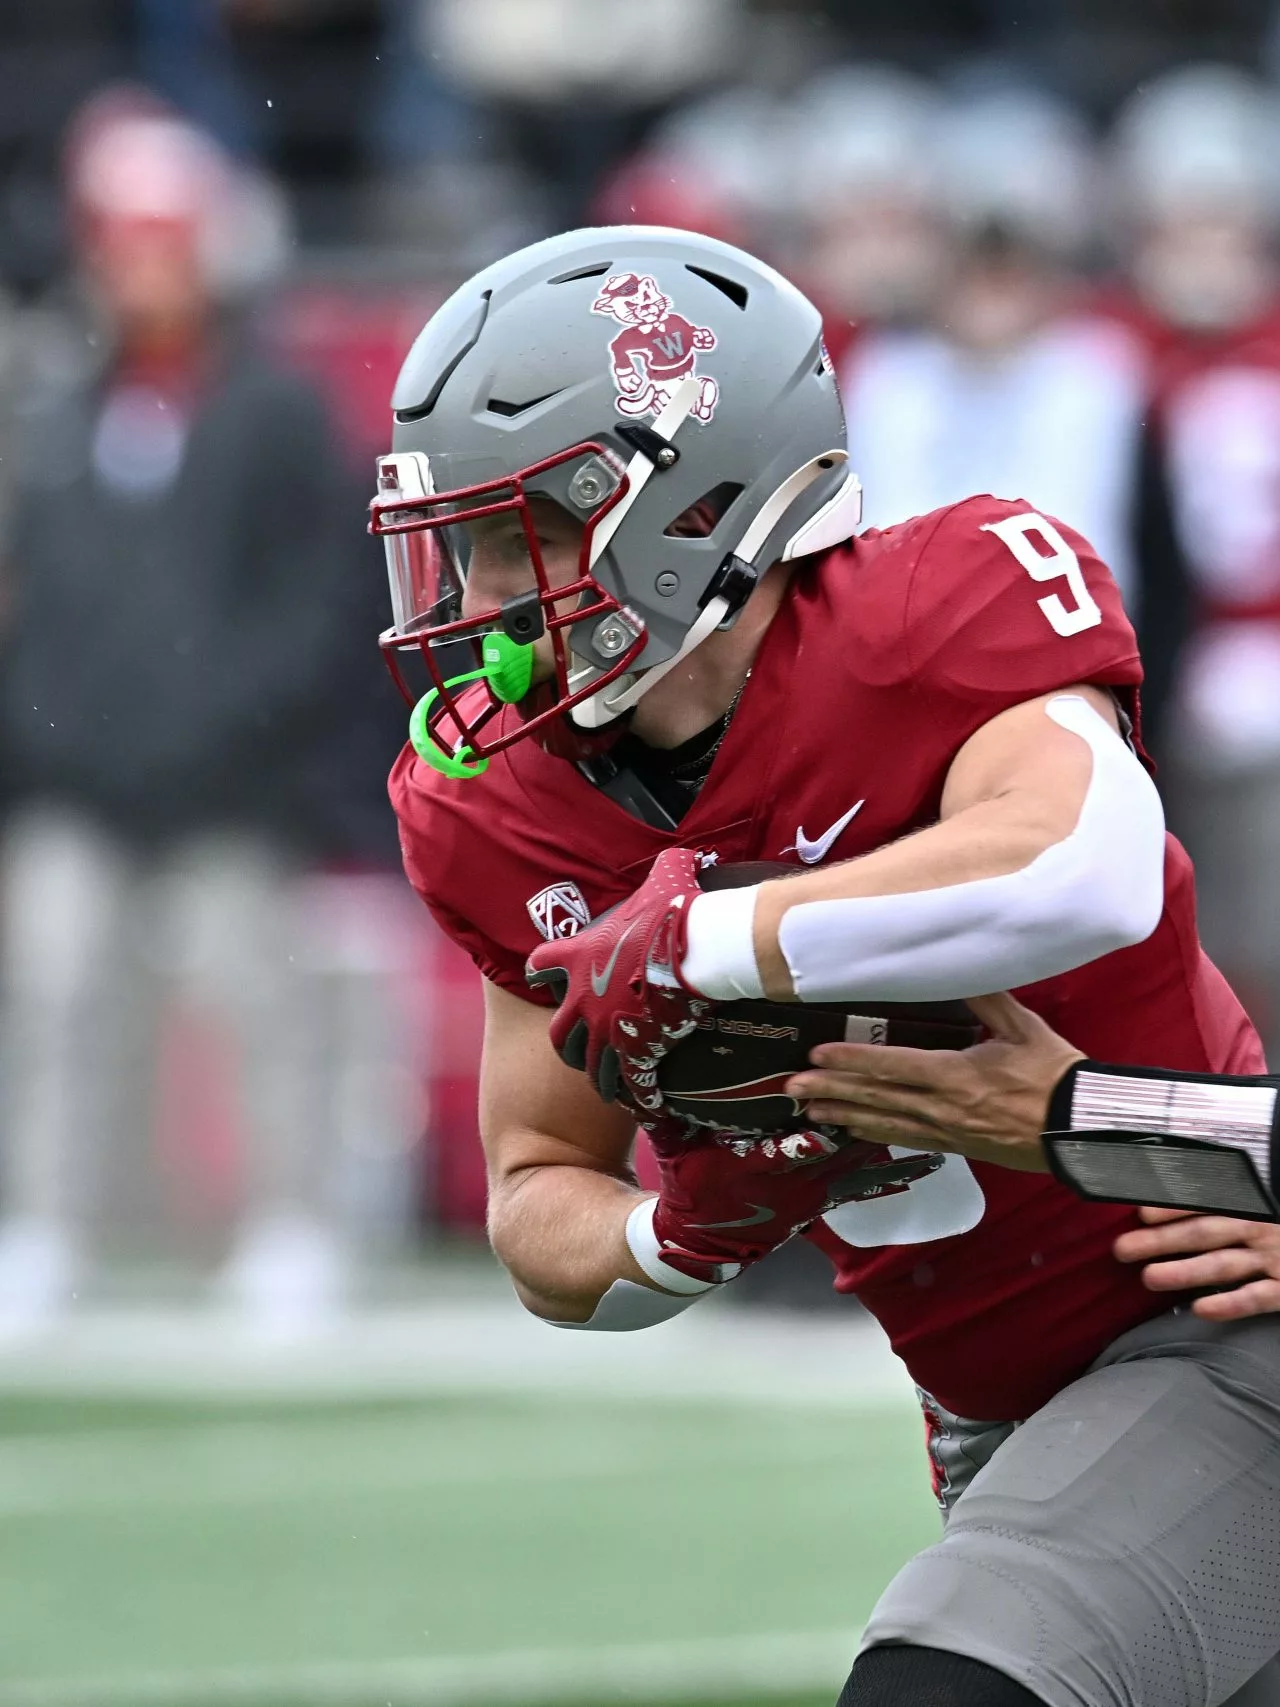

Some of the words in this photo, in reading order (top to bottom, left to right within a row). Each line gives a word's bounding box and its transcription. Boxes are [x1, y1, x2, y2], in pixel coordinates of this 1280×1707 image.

[652, 331, 684, 359] W
[978, 512, 1102, 637] 9
[528, 886, 587, 941] PAC
